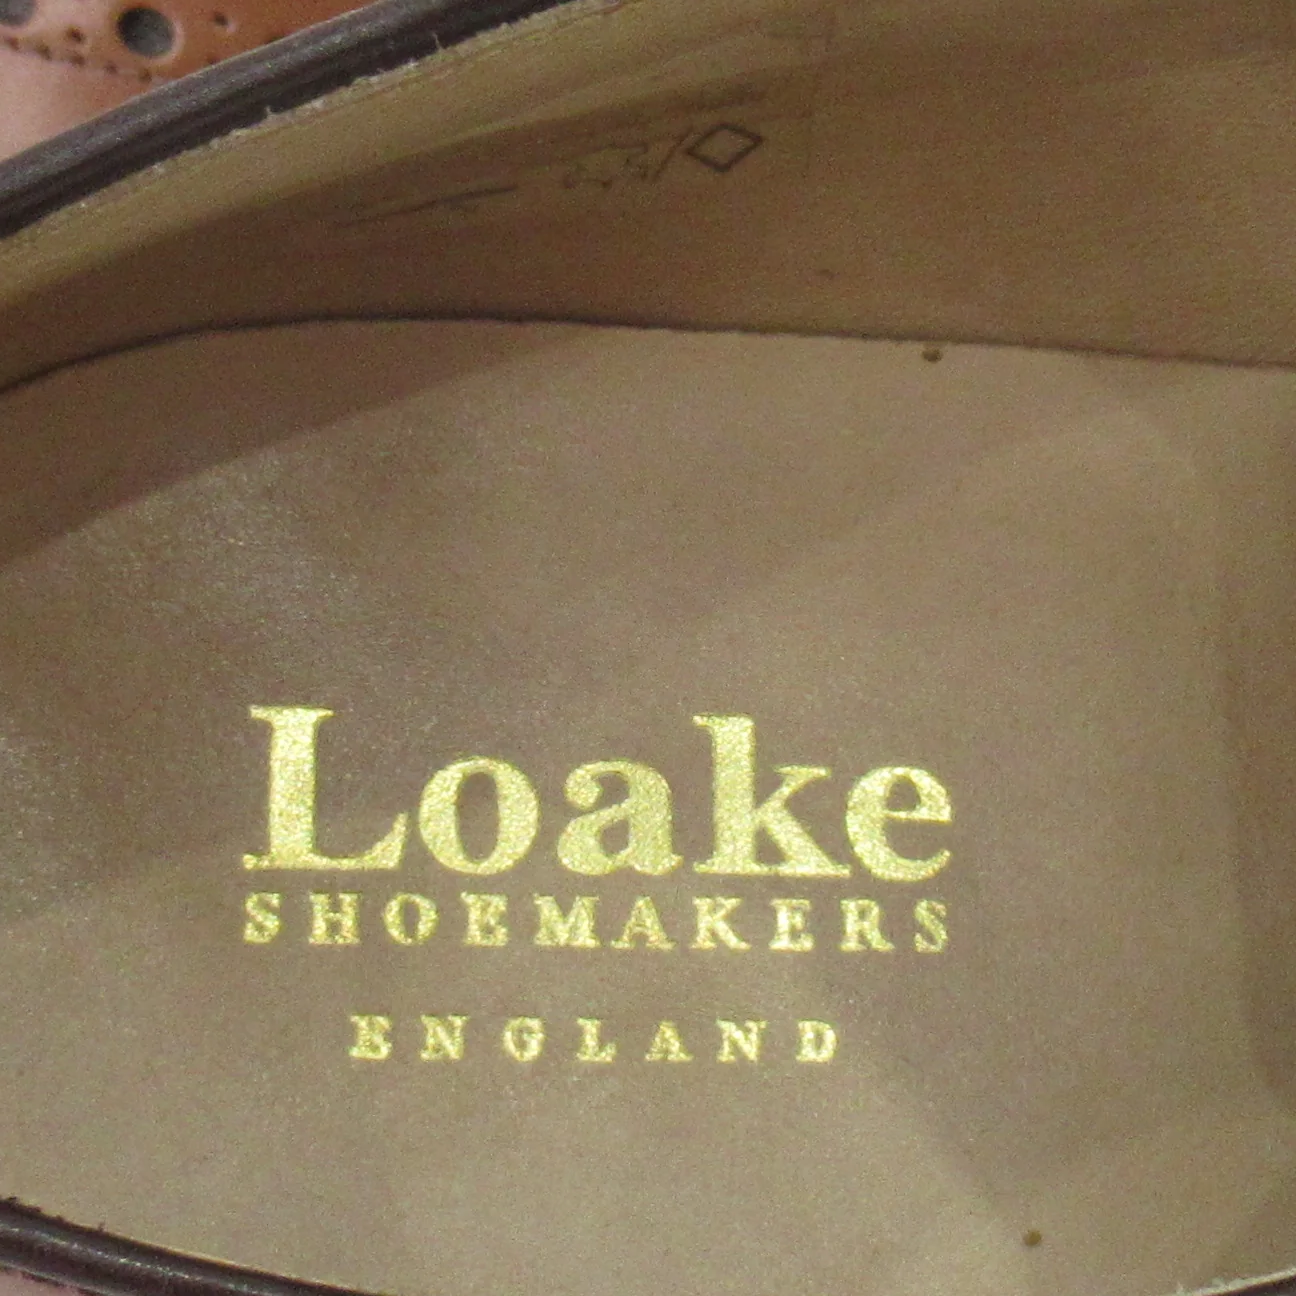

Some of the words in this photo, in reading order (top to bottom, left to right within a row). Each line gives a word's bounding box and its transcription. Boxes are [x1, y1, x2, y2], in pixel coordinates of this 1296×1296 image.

[243, 705, 953, 882] Loake
[243, 891, 949, 953] SHOEMAKERS
[349, 1014, 839, 1063] ENGLAND
